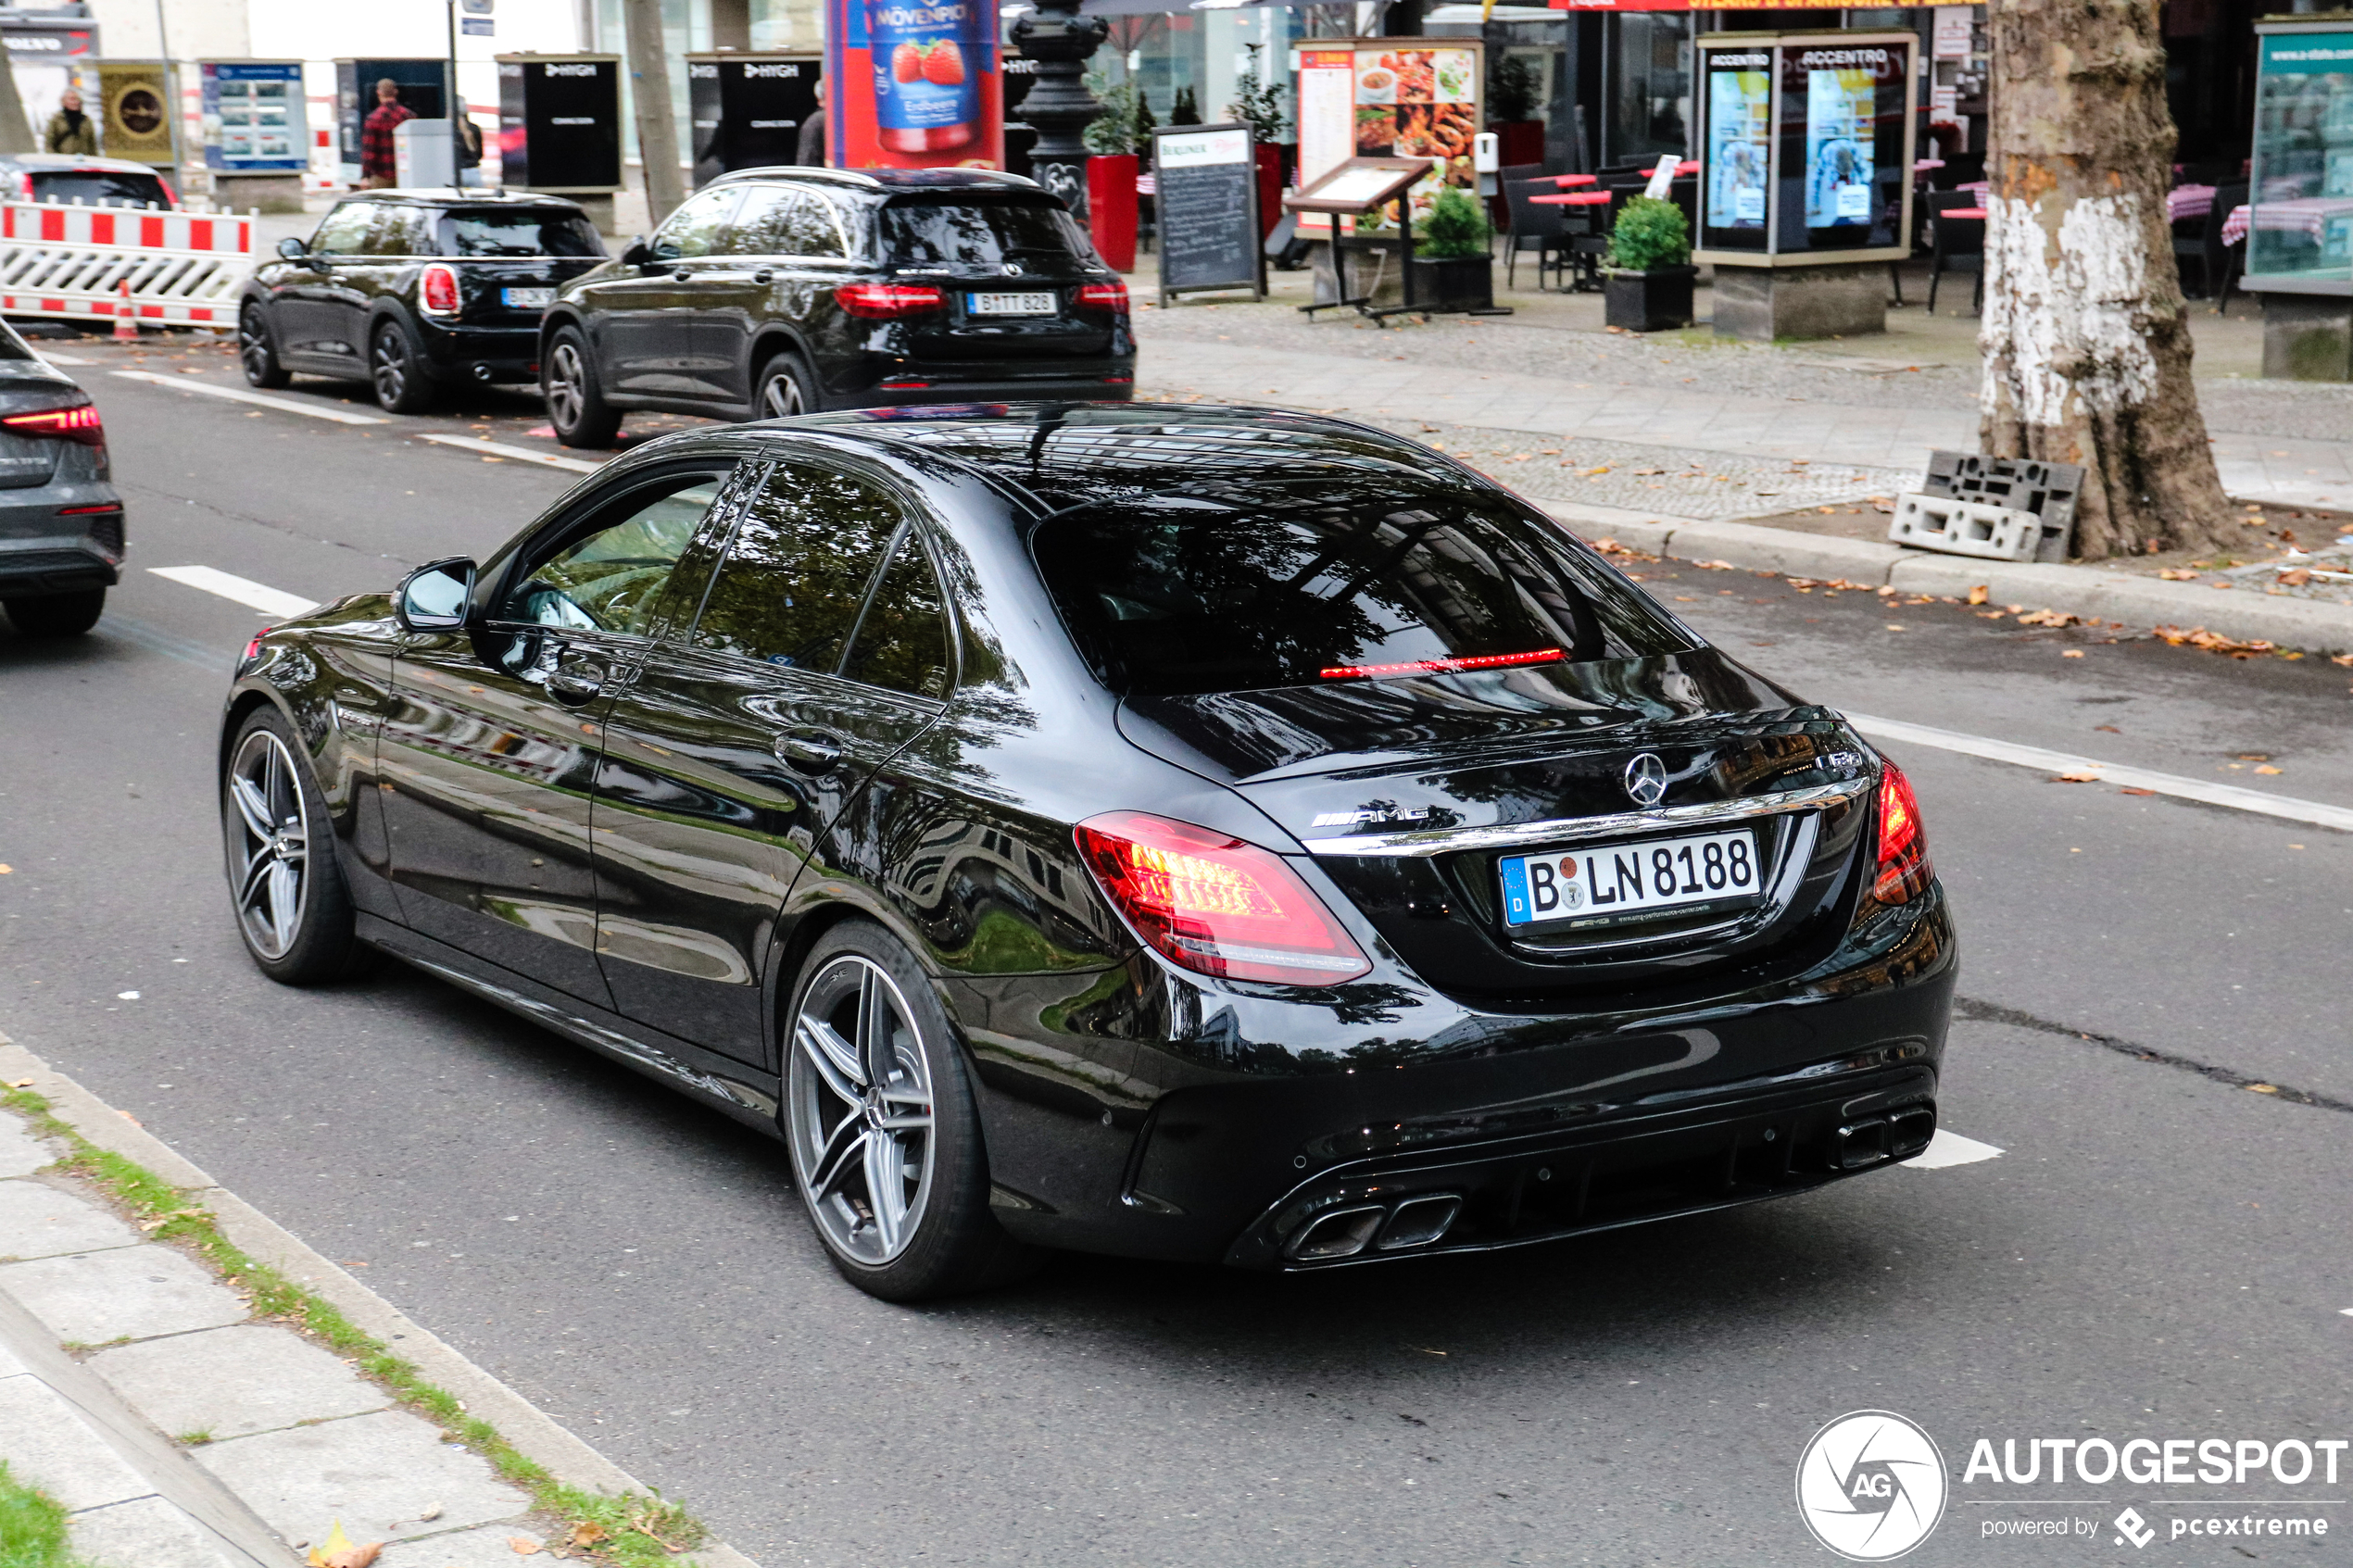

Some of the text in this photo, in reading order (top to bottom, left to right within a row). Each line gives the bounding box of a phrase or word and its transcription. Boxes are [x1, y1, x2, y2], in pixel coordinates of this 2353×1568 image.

[1709, 54, 1769, 67] ACCENTRO
[1803, 49, 1888, 65] ACCENTRO
[759, 64, 799, 78] HYGH
[1001, 295, 1019, 310] TT
[1349, 807, 1429, 824] AMG
[1529, 861, 1559, 912] B
[1586, 851, 1644, 905] LN
[1652, 839, 1752, 897] 8188
[1513, 897, 1523, 912] D
